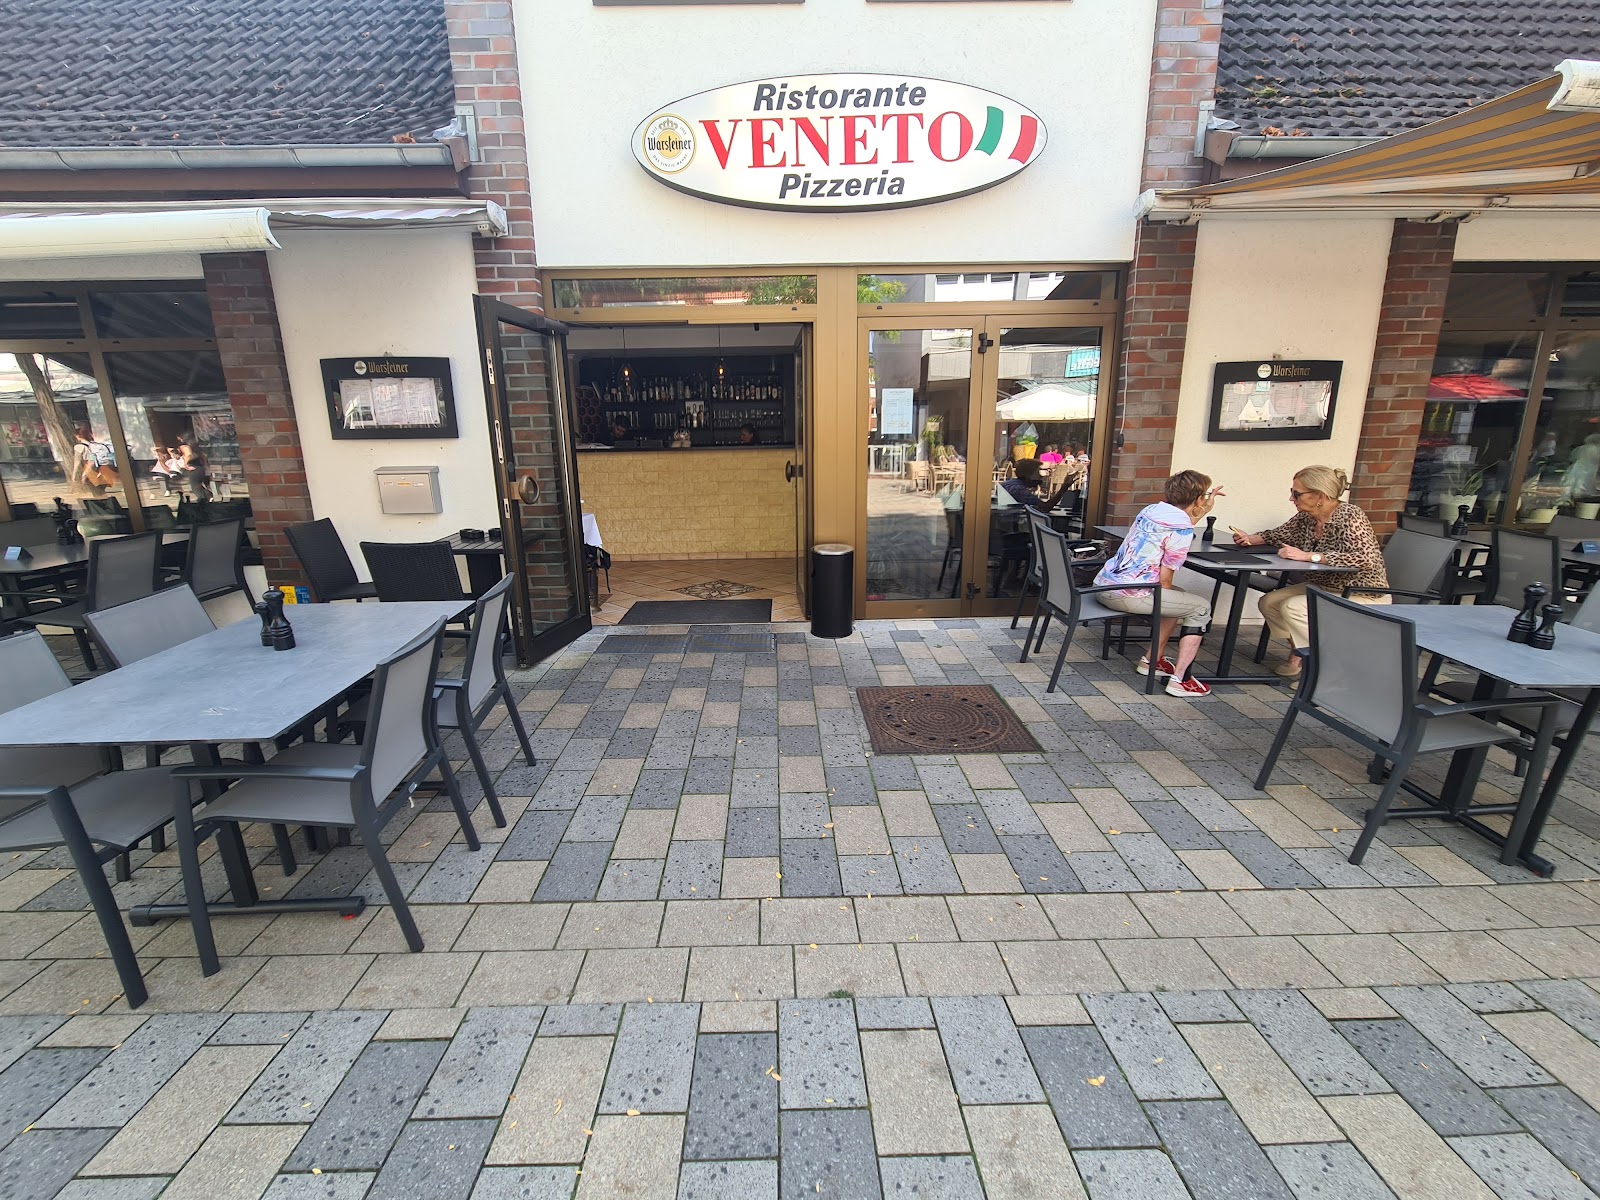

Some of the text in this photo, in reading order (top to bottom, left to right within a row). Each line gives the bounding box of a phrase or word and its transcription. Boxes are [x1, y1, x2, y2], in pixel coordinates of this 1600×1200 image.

[754, 82, 927, 111] Ristorante
[647, 135, 692, 152] Warsteiner
[698, 111, 974, 170] VENETO
[778, 170, 906, 200] Pizzeria
[367, 360, 409, 374] Warsteiner
[1273, 363, 1311, 377] Warsteiner
